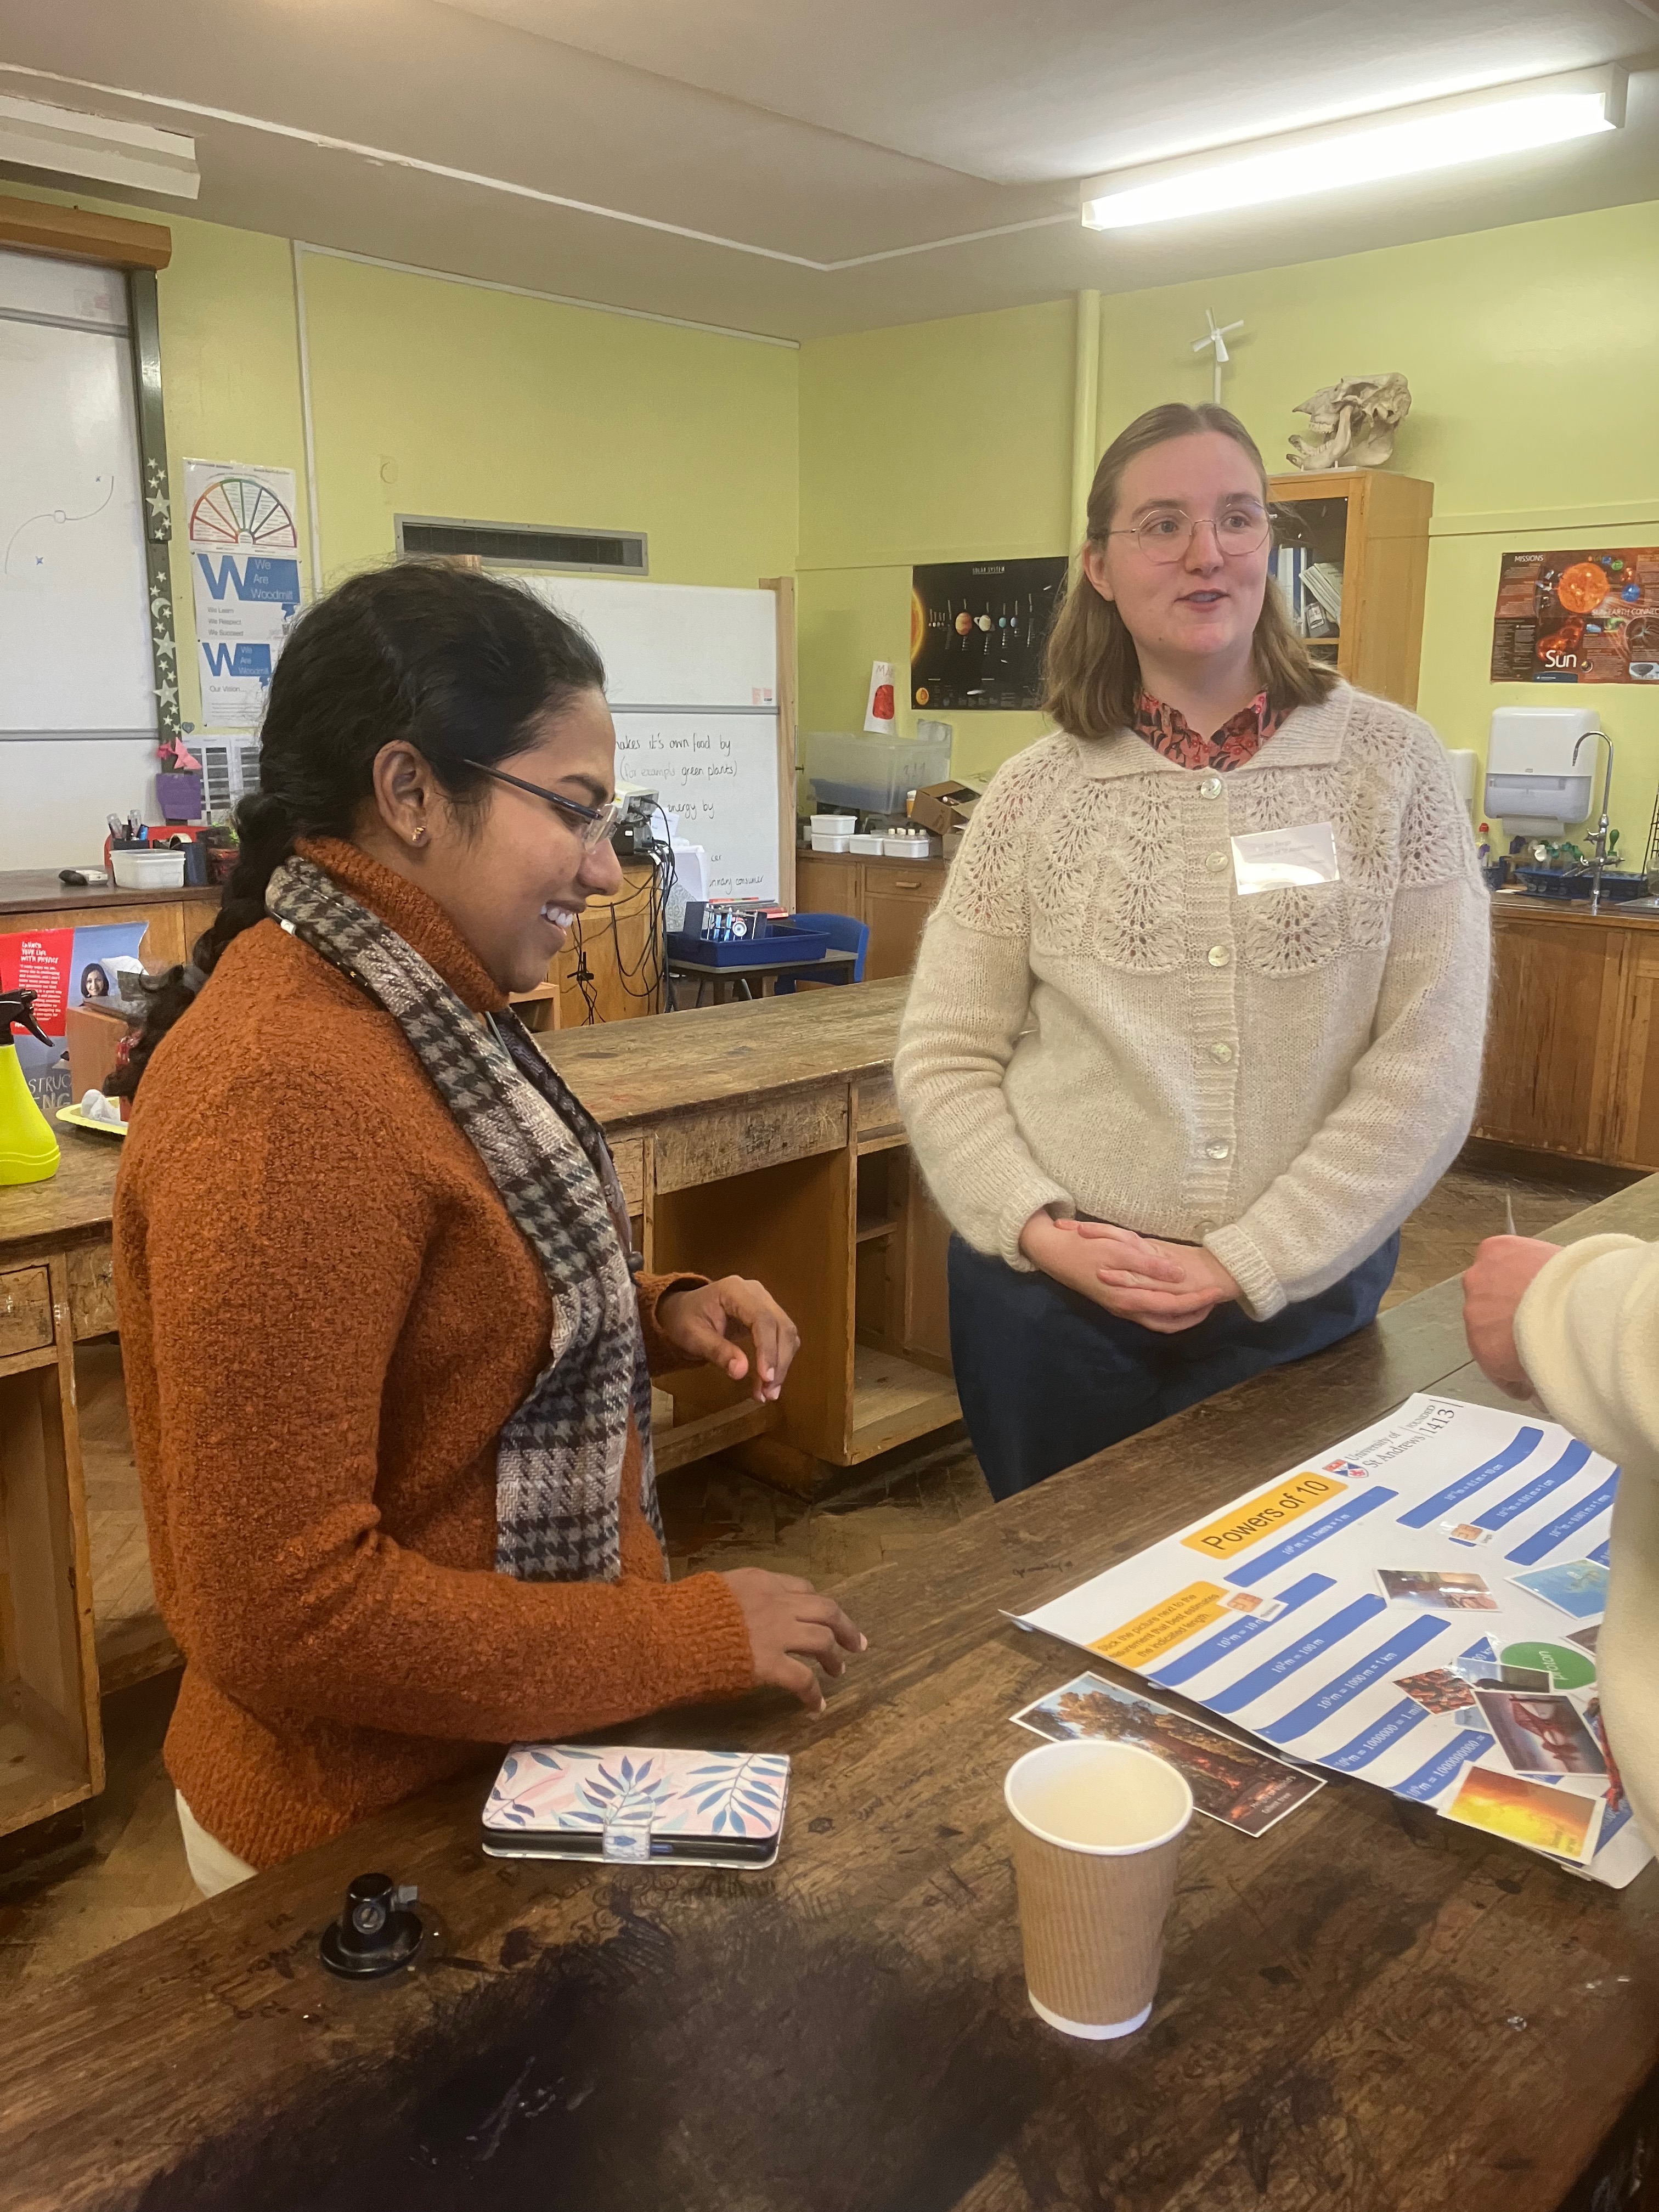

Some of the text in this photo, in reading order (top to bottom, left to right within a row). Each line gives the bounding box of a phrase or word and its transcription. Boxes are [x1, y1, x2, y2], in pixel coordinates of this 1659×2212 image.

[254, 559, 272, 570] We
[1514, 554, 1544, 562] MISSIONS
[253, 573, 269, 584] Are
[250, 588, 293, 600] Woodmill
[1545, 650, 1577, 668] Sun
[649, 732, 664, 749] it's
[669, 739, 690, 748] own
[693, 732, 710, 752] food
[719, 734, 731, 757] by
[681, 766, 704, 786] green
[667, 799, 714, 820] energy by
[29, 1074, 71, 1093] STRUC
[1405, 1404, 1436, 1429] FOUNDED
[1419, 1408, 1455, 1434] 1413
[1345, 1435, 1392, 1462] University
[1362, 1435, 1426, 1469] St Andrews
[1200, 1480, 1330, 1550] Powers of 10
[1181, 1594, 1197, 1602] the
[1245, 1622, 1259, 1630] 10
[1299, 1644, 1317, 1655] 100
[1344, 1674, 1367, 1689] 1000
[1379, 1652, 1398, 1662] km
[1538, 1650, 1569, 1680] proton
